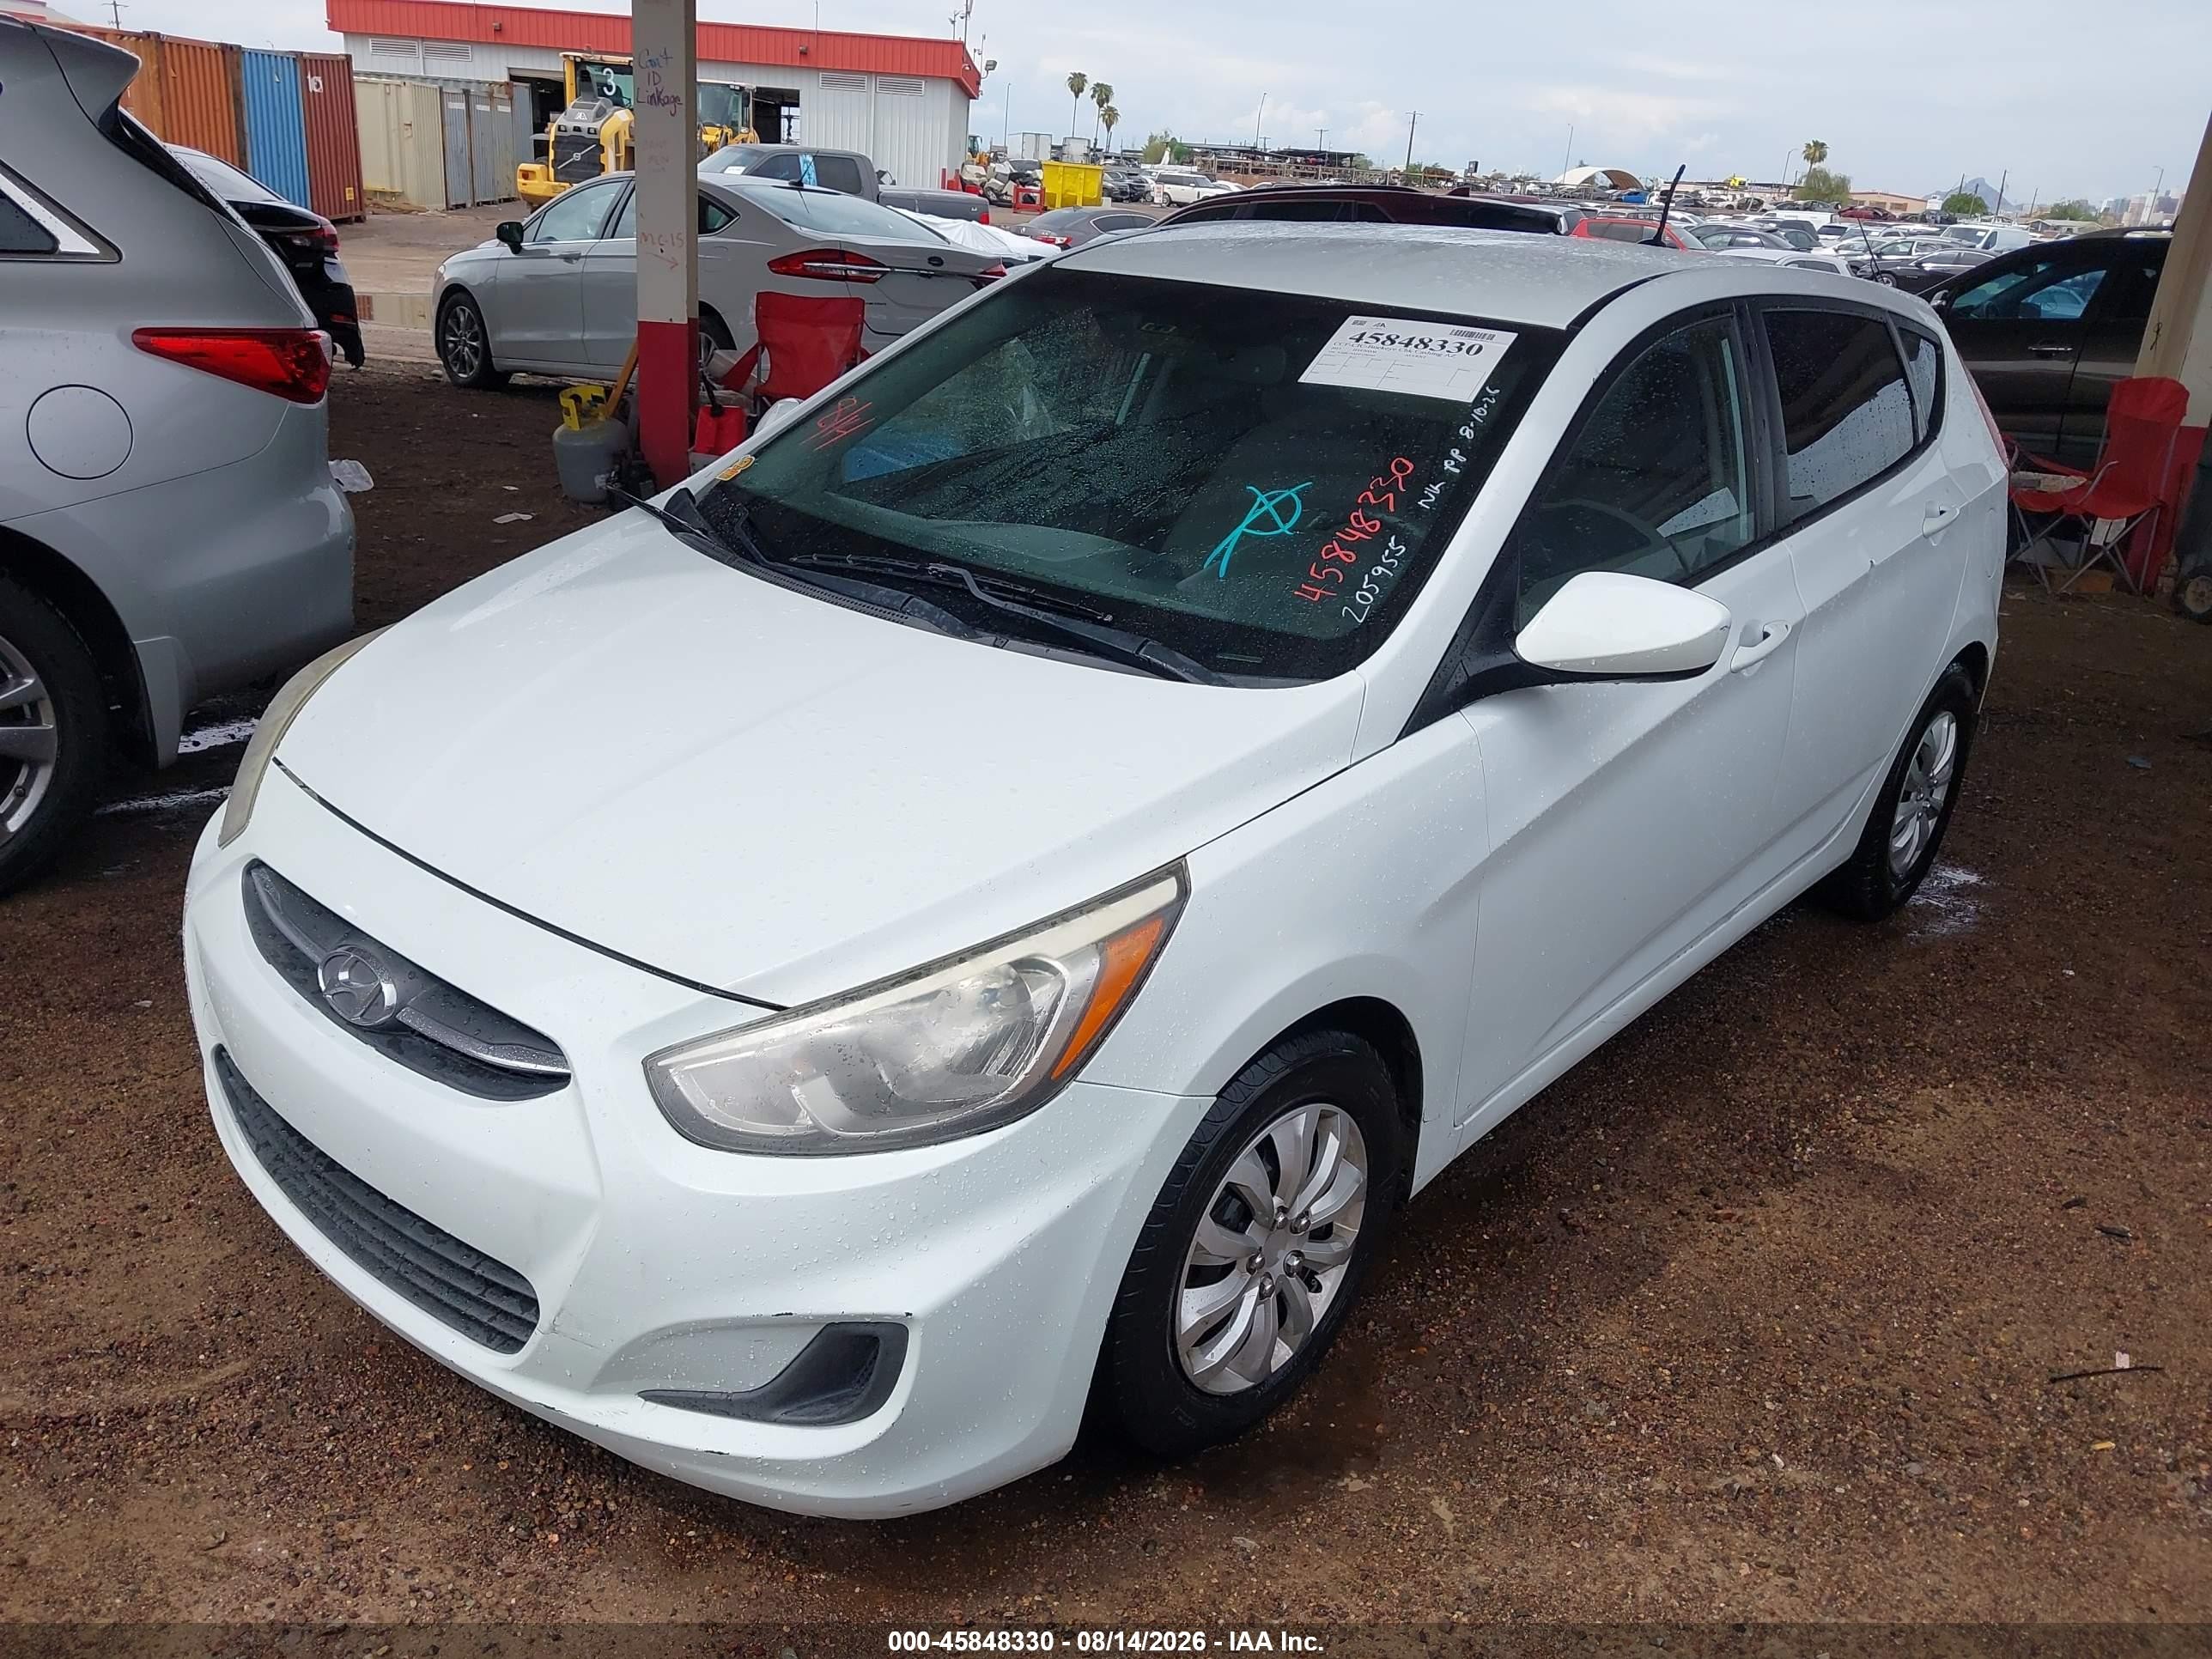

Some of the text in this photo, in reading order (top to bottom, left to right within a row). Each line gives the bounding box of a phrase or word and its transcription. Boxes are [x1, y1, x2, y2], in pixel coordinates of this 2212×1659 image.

[603, 67, 617, 96] 3
[1349, 331, 1484, 356] 45848330
[1294, 457, 1415, 602] 45848330
[1341, 535, 1407, 623] 205955
